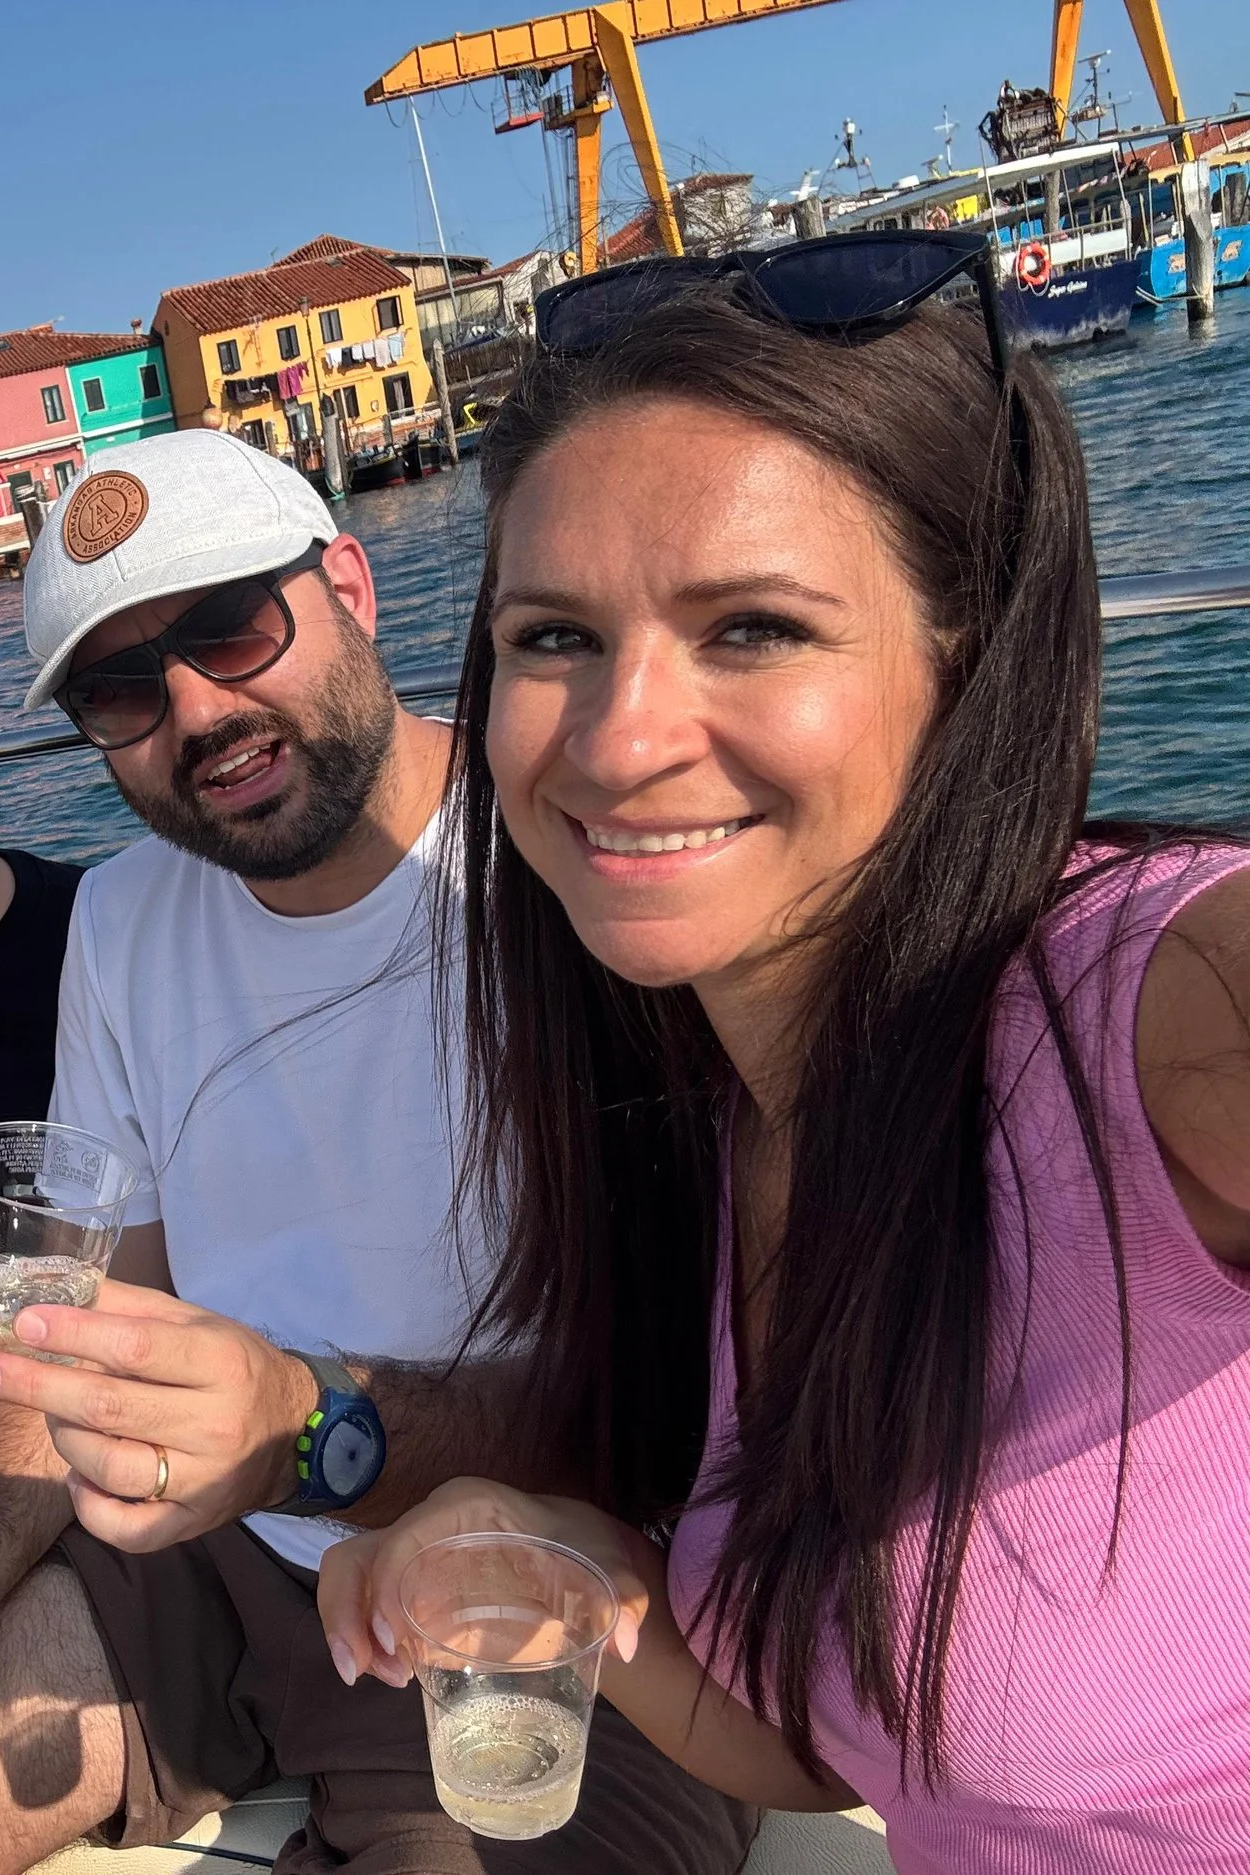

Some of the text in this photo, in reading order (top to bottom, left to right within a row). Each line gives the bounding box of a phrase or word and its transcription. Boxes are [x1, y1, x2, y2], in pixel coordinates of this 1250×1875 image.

[95, 479, 137, 497] ATHLETIC
[82, 511, 137, 554] ASSOCIATION
[87, 493, 119, 537] A
